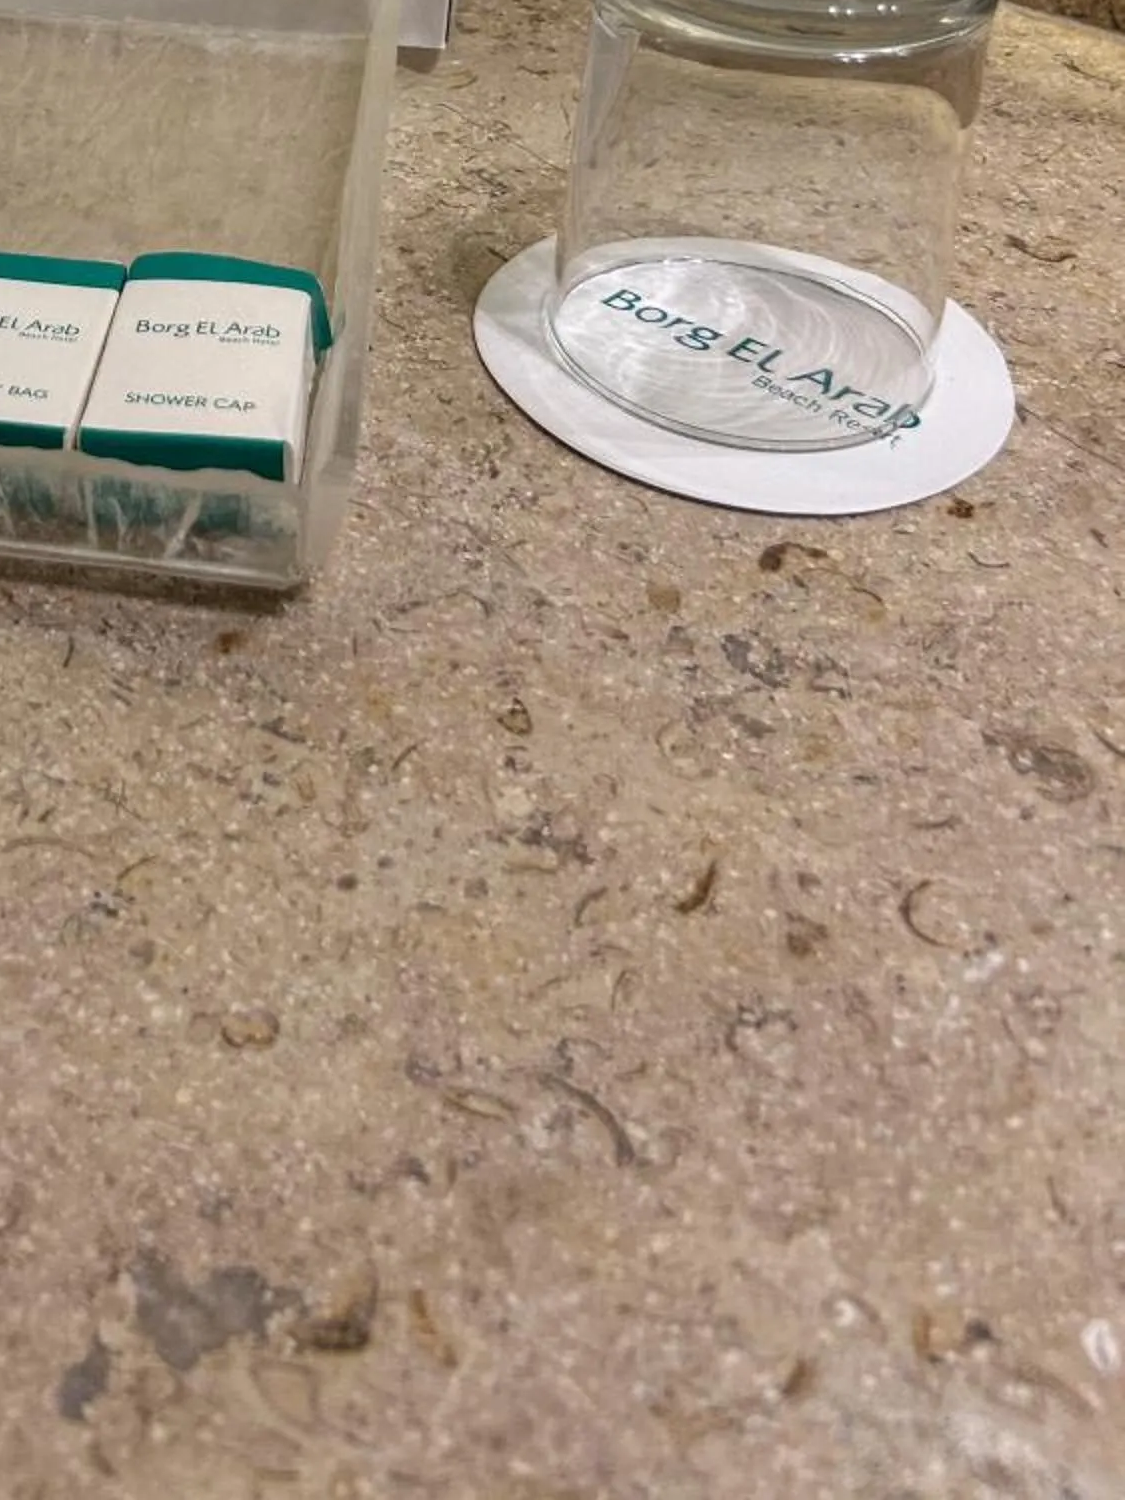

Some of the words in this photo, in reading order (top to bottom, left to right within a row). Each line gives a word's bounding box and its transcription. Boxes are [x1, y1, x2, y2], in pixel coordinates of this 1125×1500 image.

[24, 319, 81, 337] Arab
[136, 319, 191, 338] Borg
[223, 322, 281, 338] Arab
[601, 288, 723, 352] Borg
[786, 367, 922, 429] Arab
[8, 384, 50, 400] BAG
[124, 391, 208, 408] SHOWER
[213, 397, 257, 413] CAP
[751, 375, 823, 414] Beach
